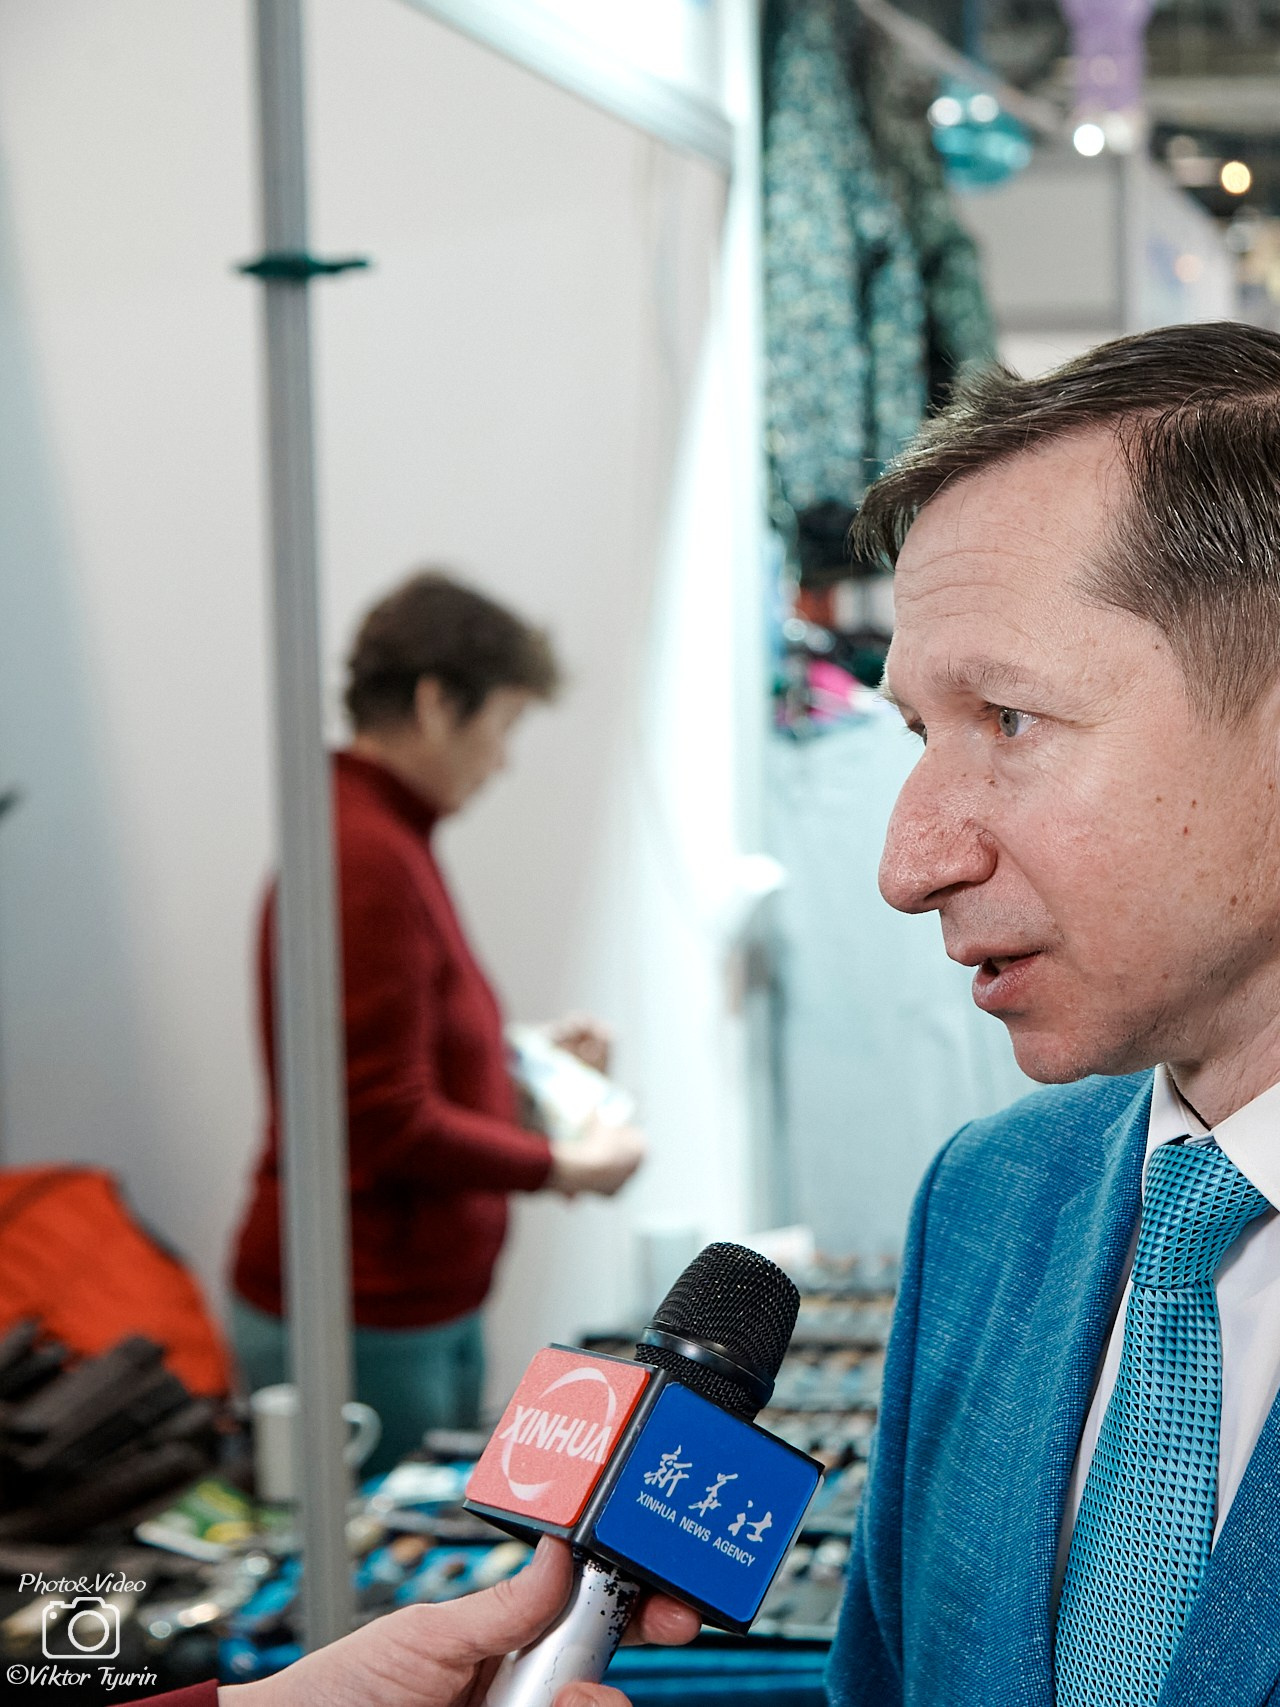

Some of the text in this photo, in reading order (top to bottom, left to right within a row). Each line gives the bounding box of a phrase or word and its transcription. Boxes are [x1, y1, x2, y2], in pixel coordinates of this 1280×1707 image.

[498, 1405, 612, 1465] XINHUA
[636, 1491, 756, 1567] XINHUA NEWS AGENCY
